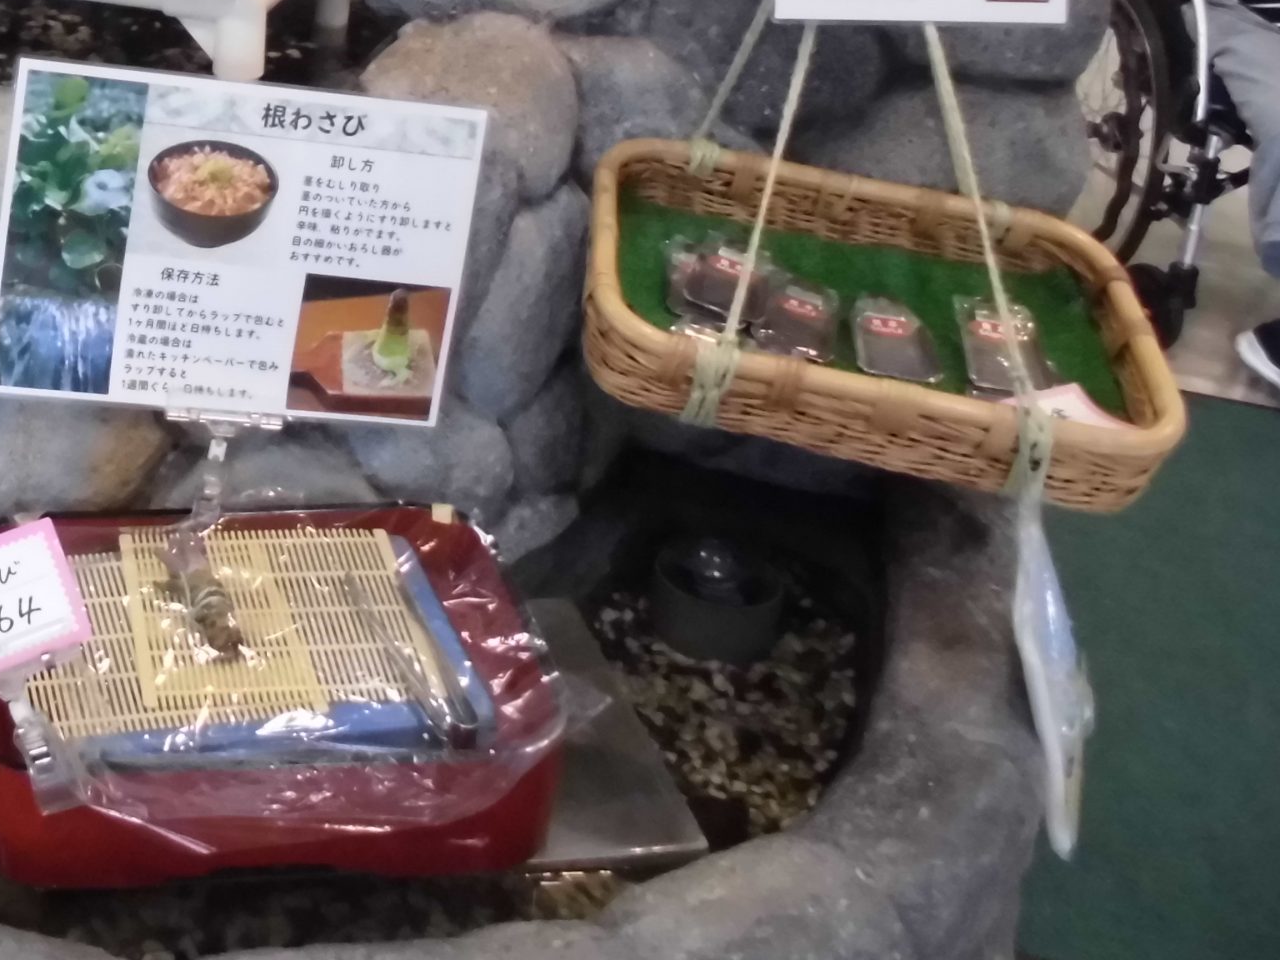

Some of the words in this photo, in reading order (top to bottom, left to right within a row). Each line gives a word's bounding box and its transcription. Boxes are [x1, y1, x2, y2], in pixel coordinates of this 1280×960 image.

[262, 102, 368, 137] 根わさび
[330, 154, 375, 173] 卸し方
[297, 205, 452, 232] 円を描くようにすり卸しますと
[289, 252, 361, 269] おすすめです。
[160, 266, 221, 287] 保存方法
[132, 287, 200, 304] 冷凍の場合は
[130, 303, 285, 328] すり卸してからラップで包むと
[126, 333, 193, 349] 冷蔵の場合は
[123, 363, 188, 380] ラップすると
